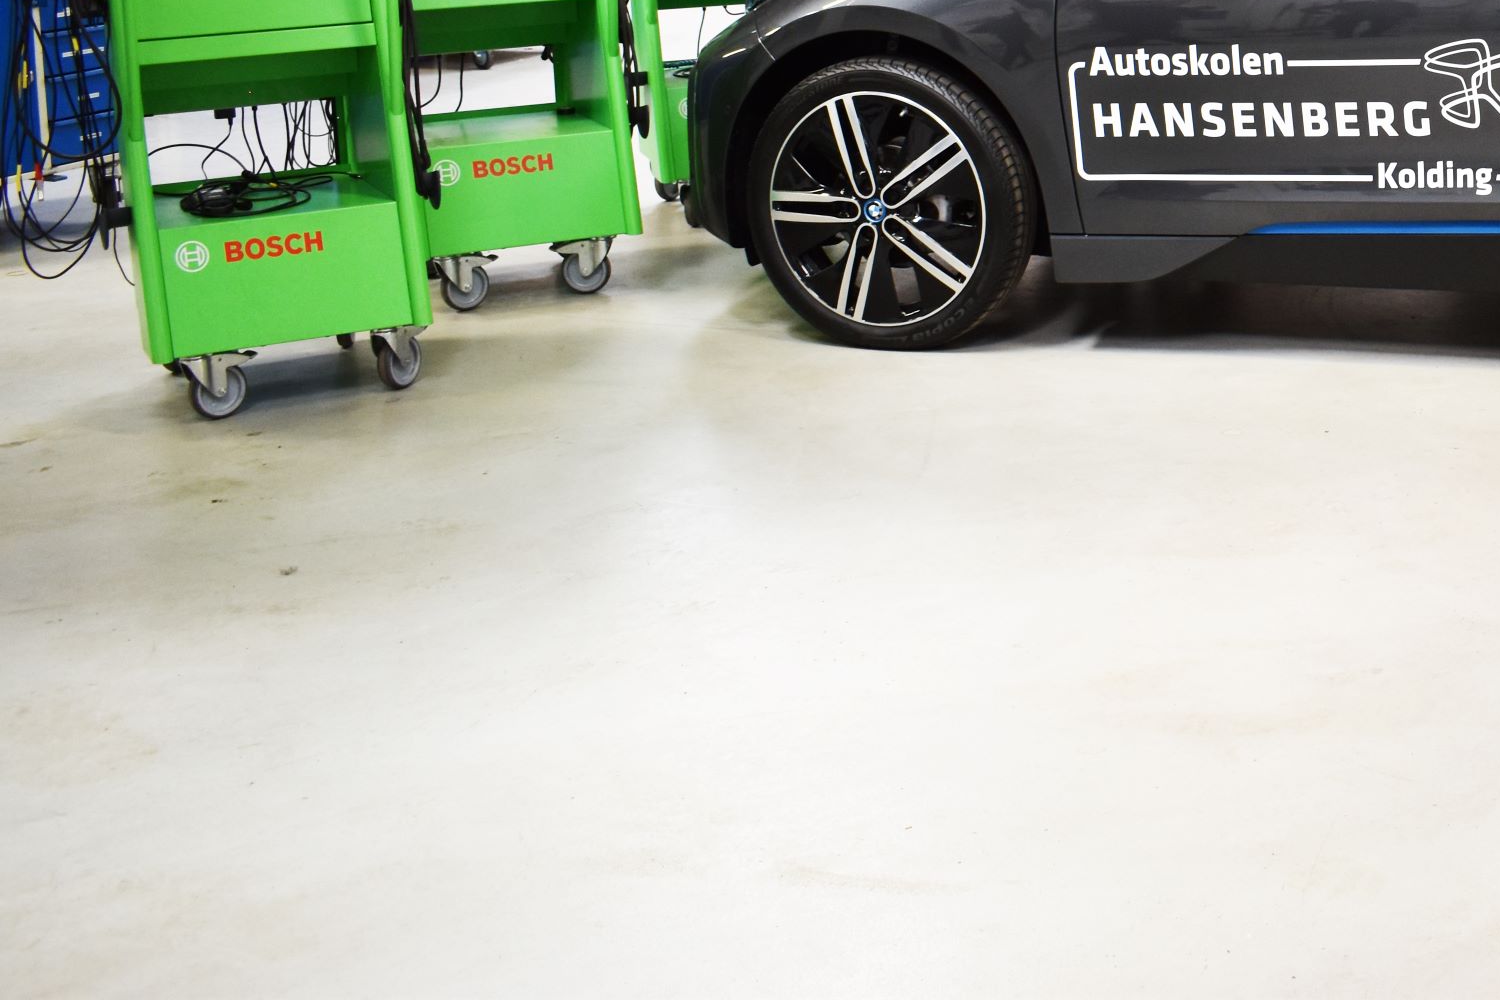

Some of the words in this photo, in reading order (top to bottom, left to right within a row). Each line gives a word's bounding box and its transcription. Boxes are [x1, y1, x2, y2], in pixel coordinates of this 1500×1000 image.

[1089, 43, 1284, 77] Autoskolen
[1092, 100, 1431, 138] HANSENBERG
[472, 152, 554, 179] BOSCH
[1377, 160, 1493, 196] Kolding
[223, 230, 324, 263] BOSCH
